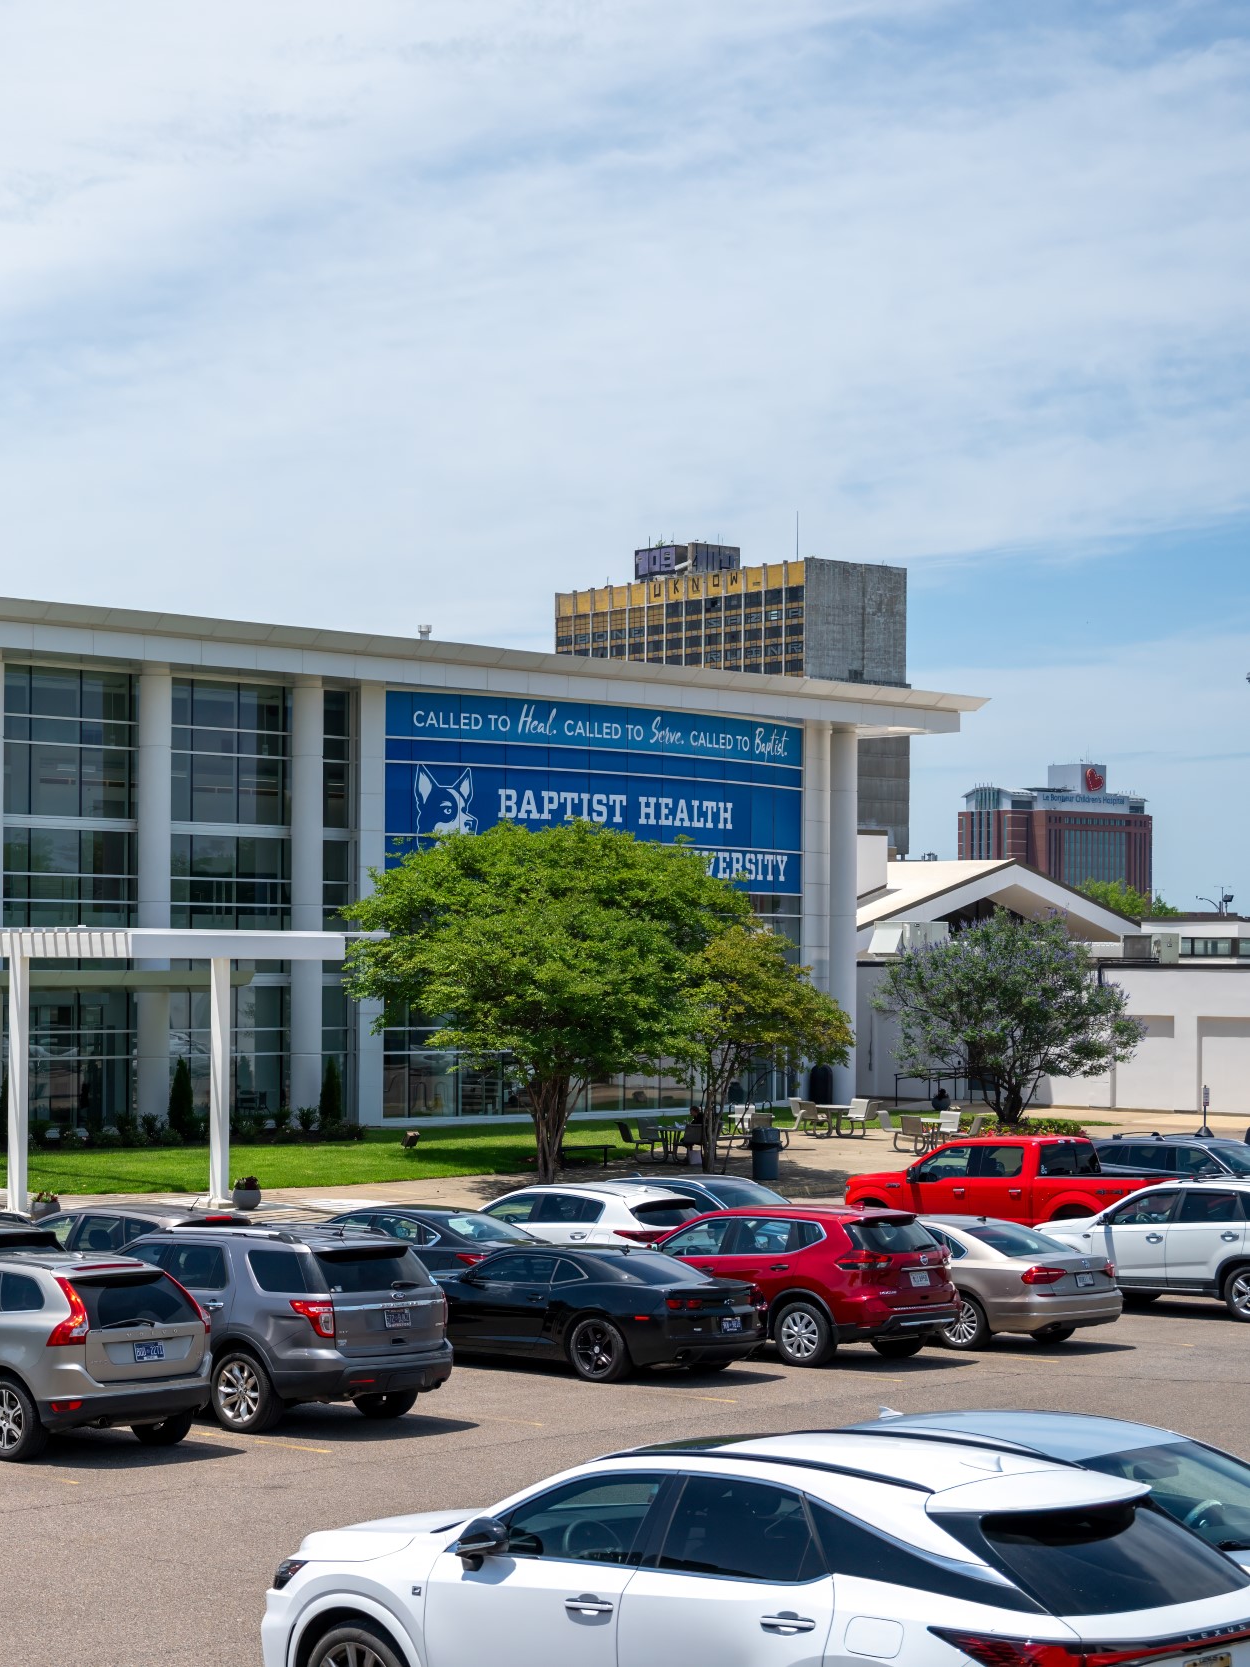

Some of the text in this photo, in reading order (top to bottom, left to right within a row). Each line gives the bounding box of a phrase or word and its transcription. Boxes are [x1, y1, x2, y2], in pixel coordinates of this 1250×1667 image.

[413, 704, 789, 762] CALLED TO Heal. CALLED TO Serve. CALLED TO Baptist.
[1076, 795, 1101, 804] Children's
[1103, 796, 1125, 806] Hospital
[498, 789, 733, 830] BAPTIST HEALTH
[126, 1329, 178, 1337] VOLVO
[1187, 1624, 1246, 1641] LEXUS
